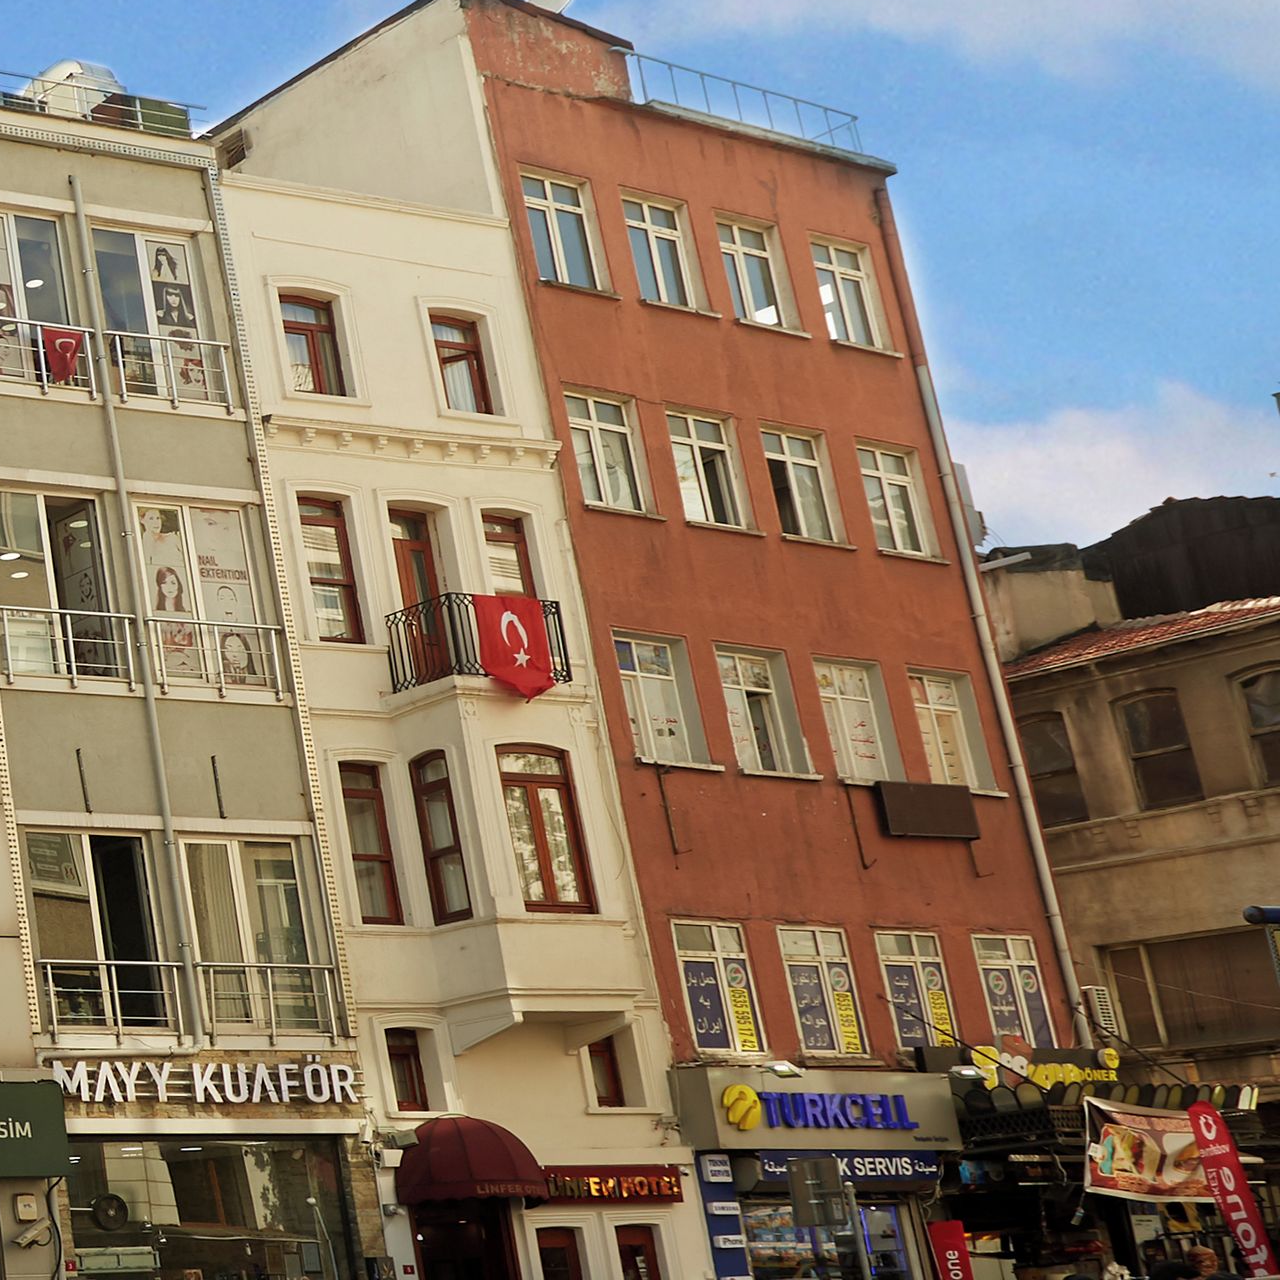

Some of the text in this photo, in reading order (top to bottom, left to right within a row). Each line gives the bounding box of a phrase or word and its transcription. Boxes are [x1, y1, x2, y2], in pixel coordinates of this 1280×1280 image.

[198, 554, 218, 566] NAIL
[52, 1054, 359, 1103] MAYY KUAFÖR
[758, 1091, 919, 1130] TURKCELL
[854, 1157, 913, 1176] SERVIS
[476, 1183, 524, 1195] LİNFER
